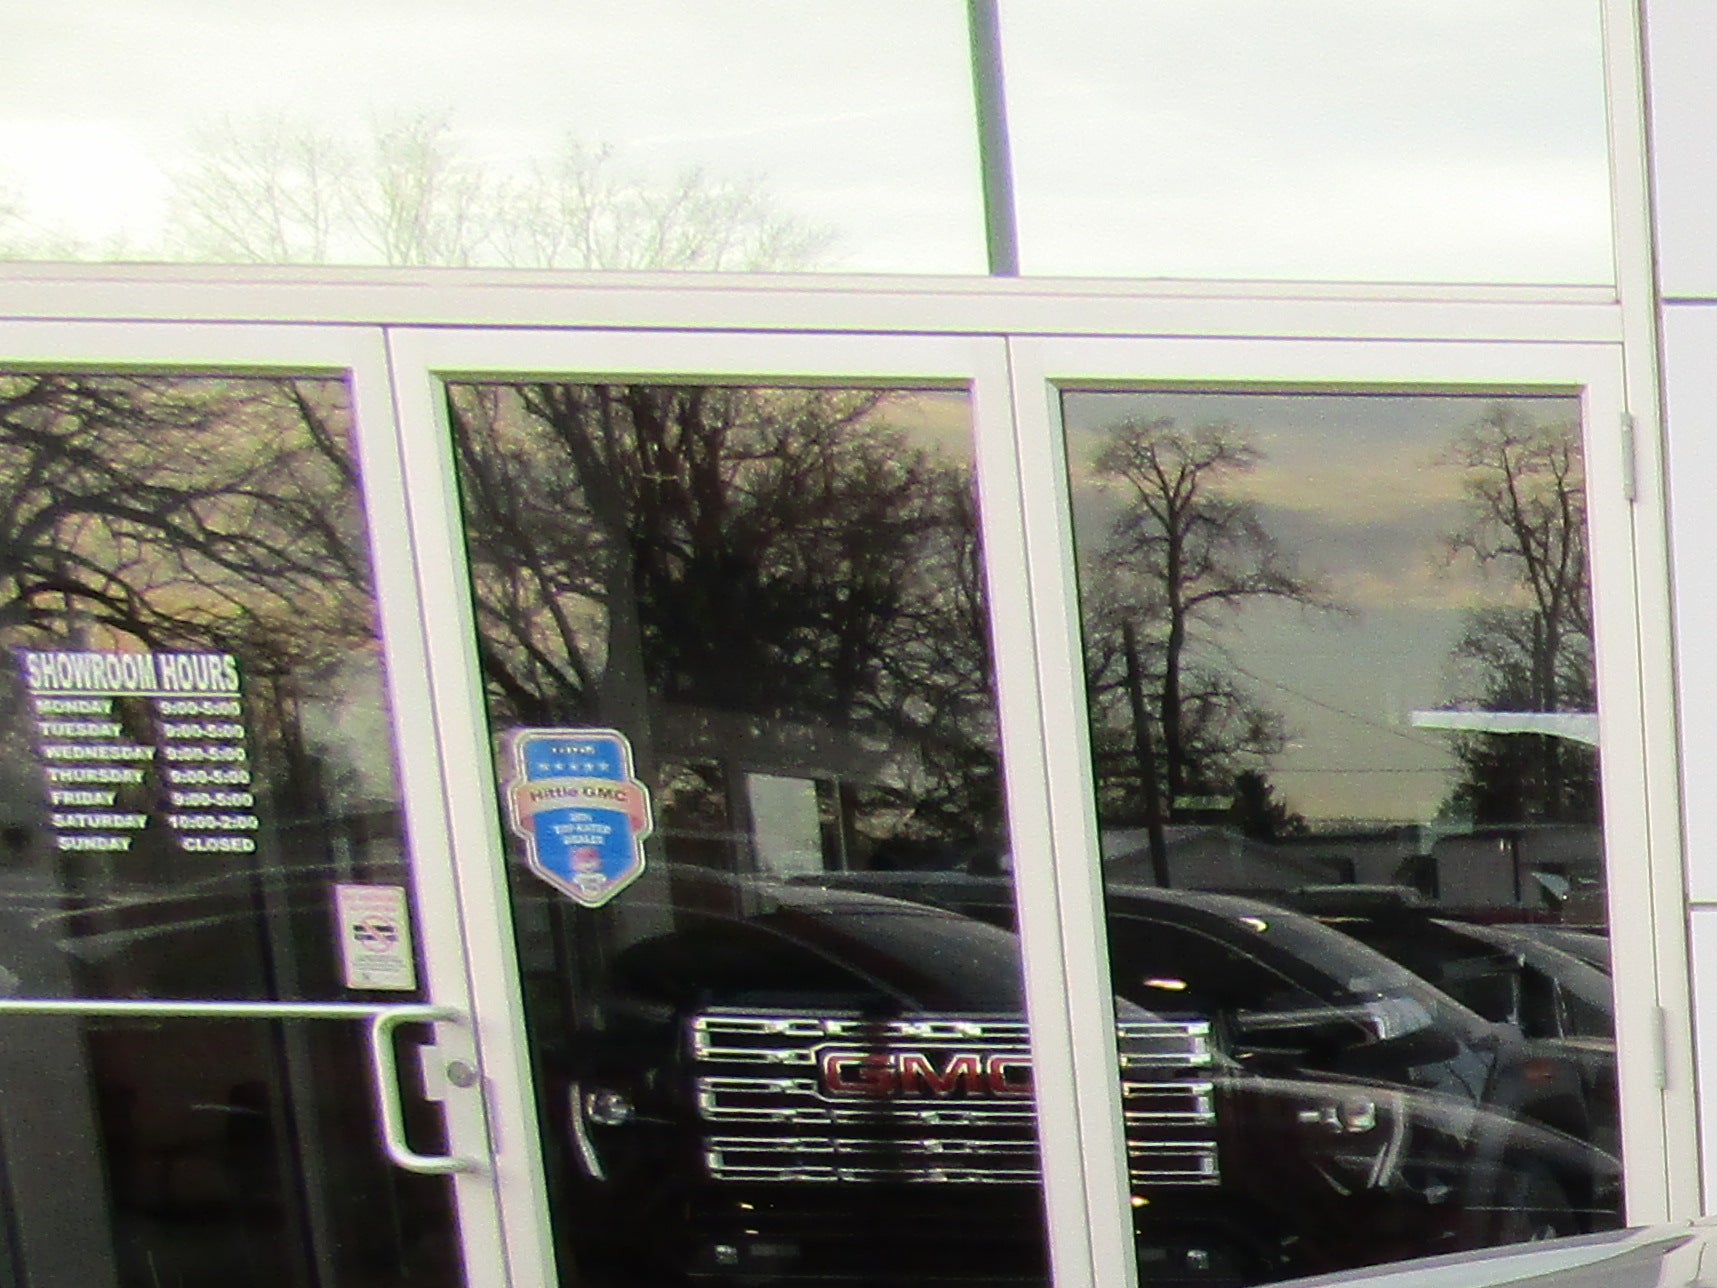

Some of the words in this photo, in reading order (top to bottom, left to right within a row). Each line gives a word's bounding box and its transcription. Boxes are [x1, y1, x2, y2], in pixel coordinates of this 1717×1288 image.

[26, 652, 158, 690] SHOWROOM
[158, 653, 240, 691] HOURS
[35, 699, 112, 714] MONDAY
[38, 722, 122, 736] TUESDAY
[44, 745, 156, 760] WEDNESDAY
[47, 768, 145, 783] THURSDAY
[50, 790, 117, 806] FRIDAY
[582, 785, 629, 802] GMC
[51, 813, 147, 829] SATURDAY
[56, 836, 132, 850] SUNDAY
[181, 837, 255, 852] CLOSED
